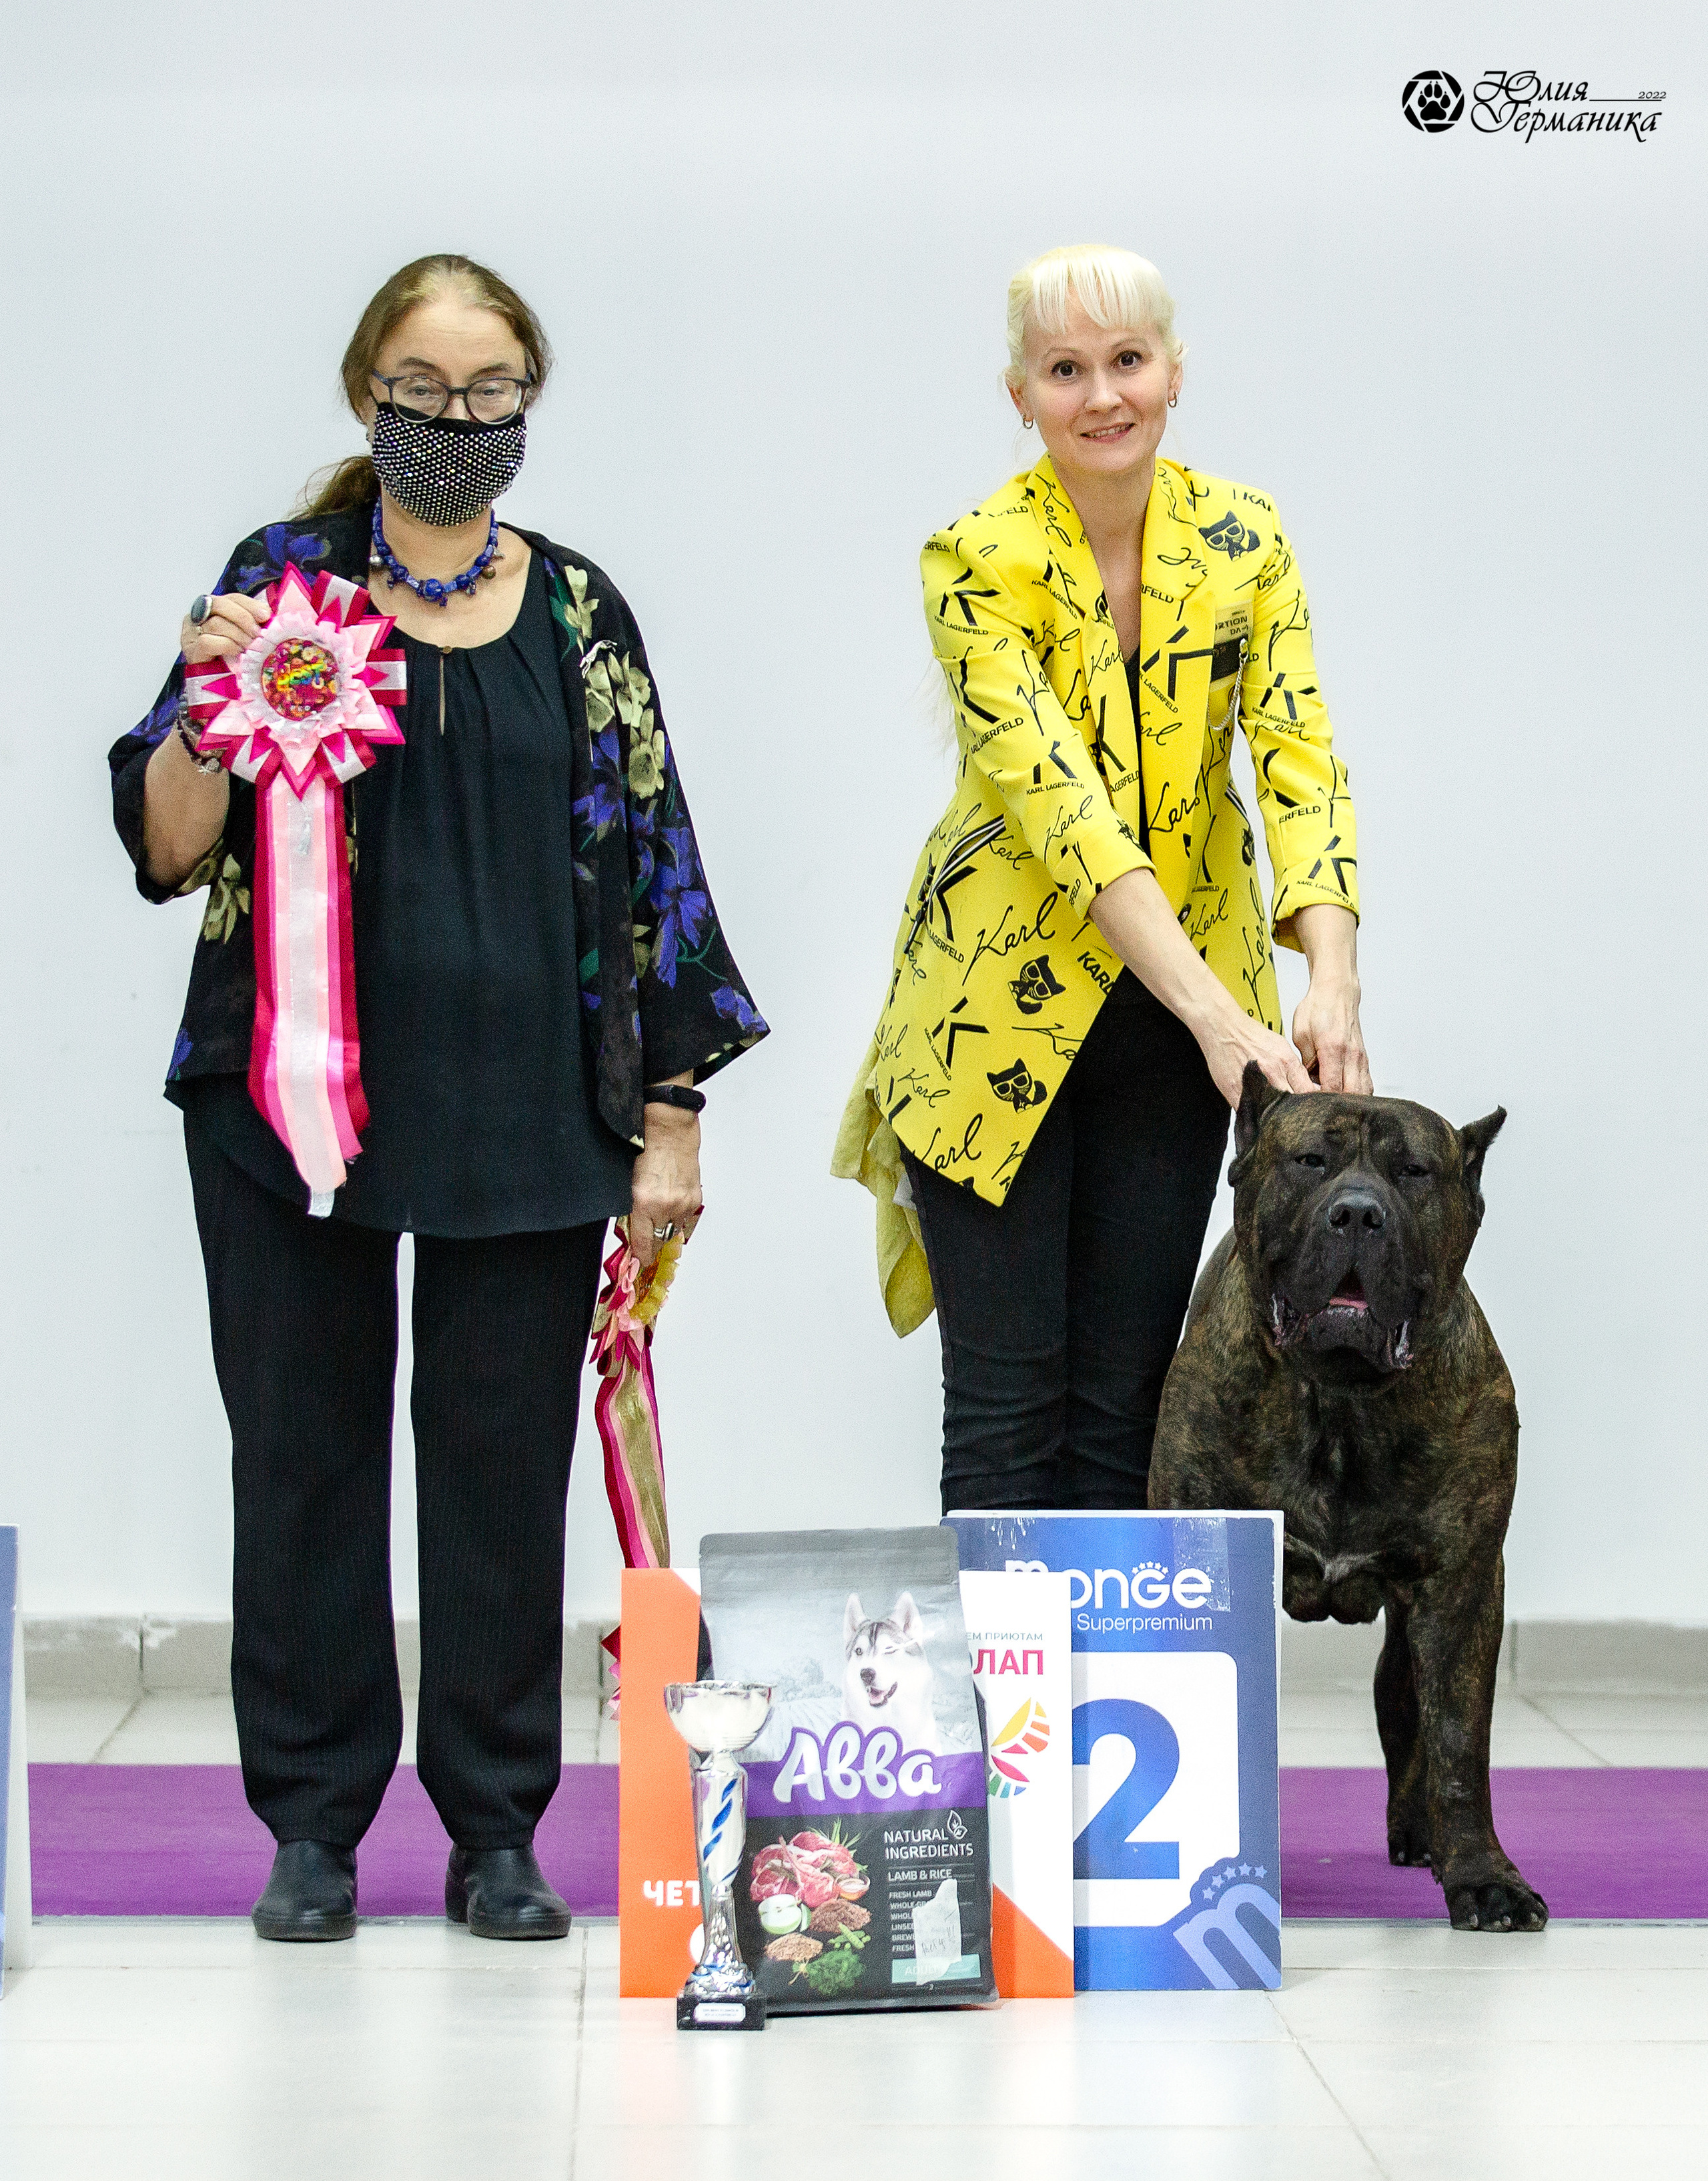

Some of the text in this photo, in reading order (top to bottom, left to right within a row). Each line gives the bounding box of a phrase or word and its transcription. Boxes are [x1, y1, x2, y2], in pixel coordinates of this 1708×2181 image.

[1144, 678, 1179, 714] LAGERFELD
[1025, 786, 1045, 796] KARL
[962, 891, 1059, 986] Karl
[1077, 1612, 1213, 1634] Superpremium
[985, 1632, 1043, 1641] ПРИЮТАМ
[973, 1648, 1043, 1675] ЛАП
[1072, 1698, 1180, 1879] 2
[884, 1828, 949, 1843] NATURAL
[885, 1843, 973, 1859] INGREDIENTS
[888, 1871, 917, 1881] LAMB
[919, 1870, 928, 1880] &
[929, 1869, 952, 1879] RICE
[891, 1912, 914, 1920] WHOL
